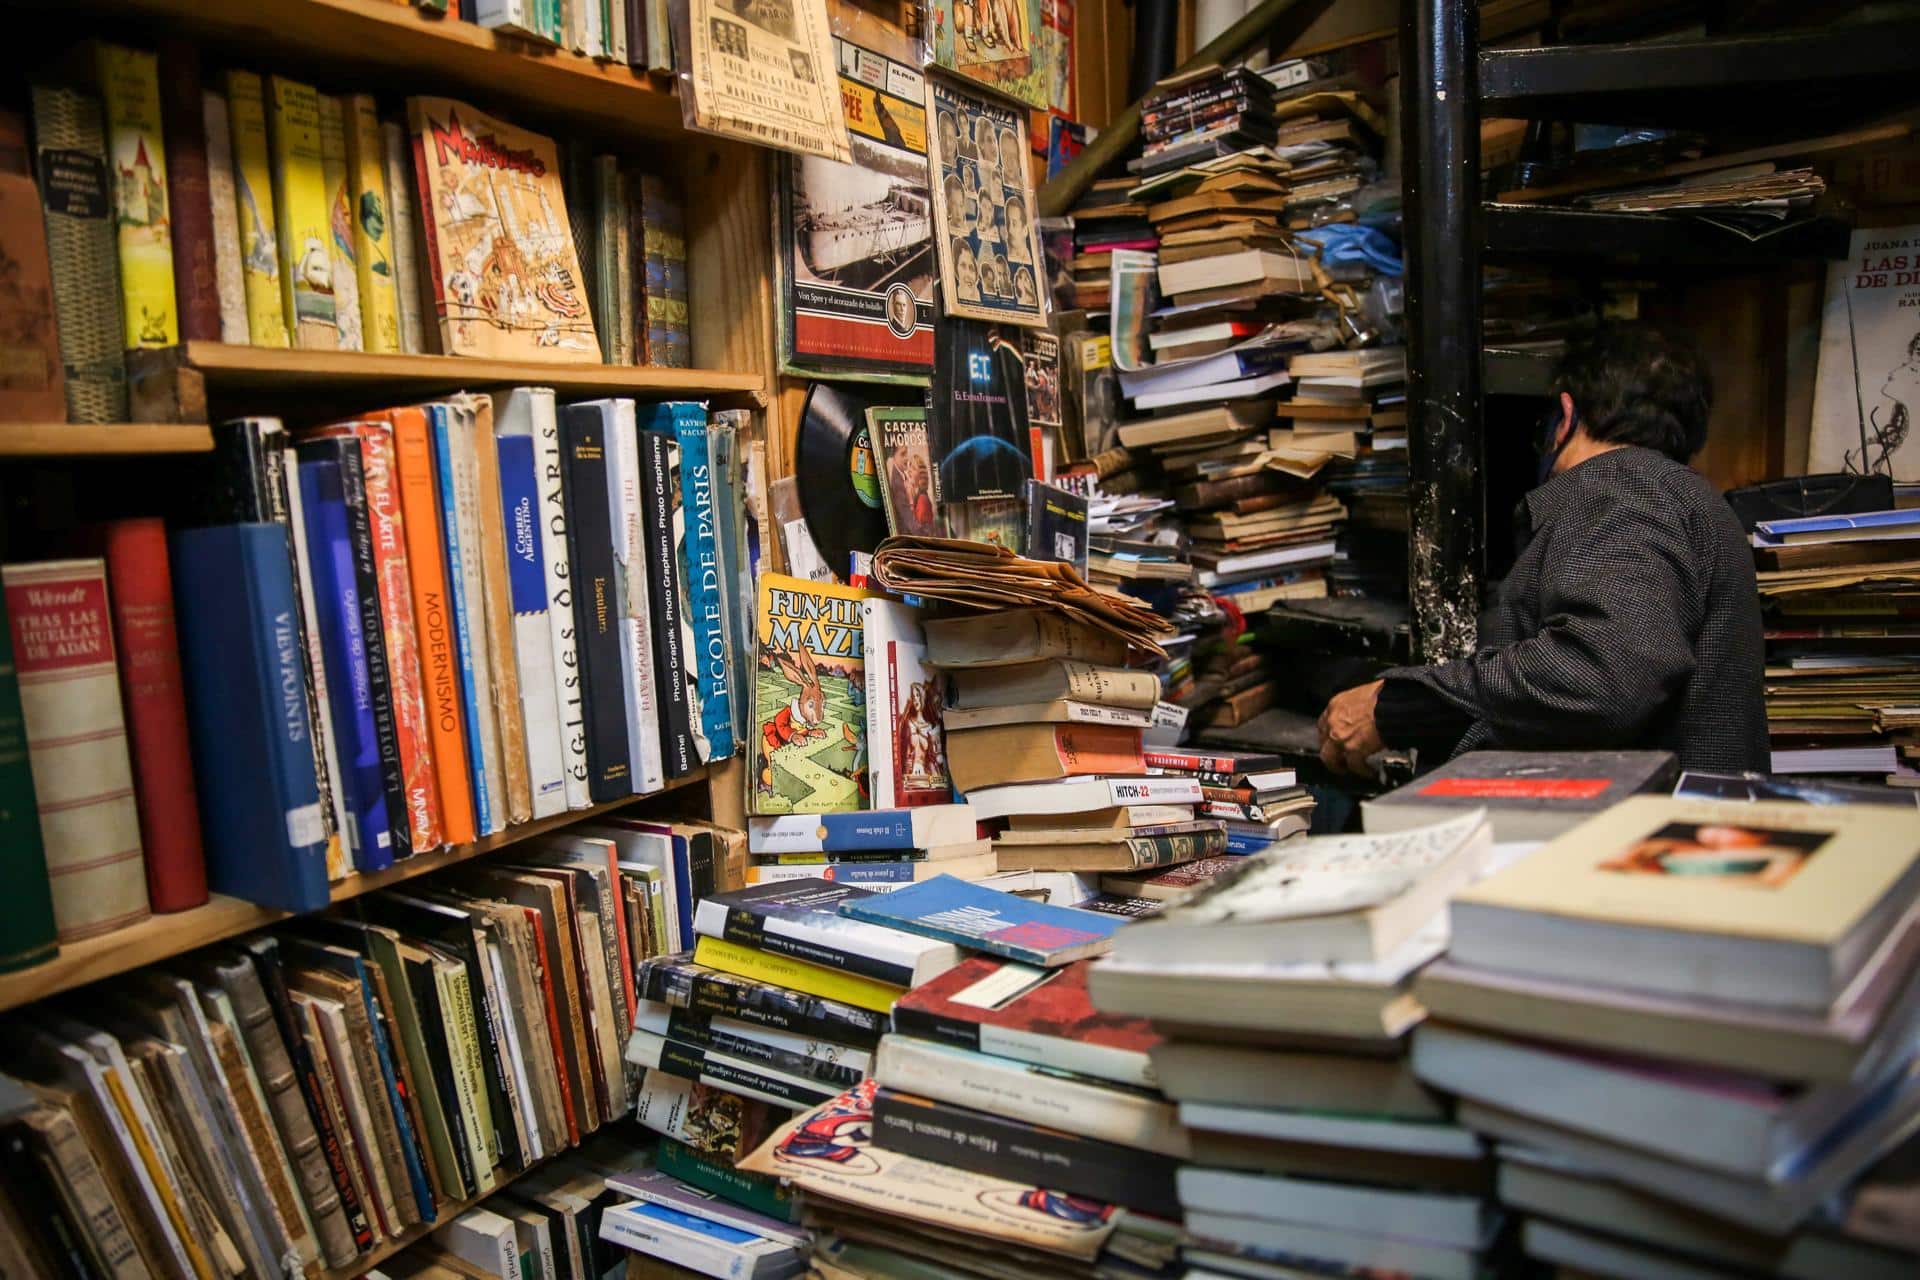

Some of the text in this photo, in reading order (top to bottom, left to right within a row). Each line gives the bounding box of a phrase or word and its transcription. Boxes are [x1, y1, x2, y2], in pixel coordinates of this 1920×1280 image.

[1864, 239, 1909, 250] JUANA
[1862, 256, 1908, 272] LAS
[1856, 273, 1888, 288] DE
[884, 421, 927, 432] CARTAS
[378, 510, 397, 550] ARTE
[514, 506, 530, 554] CORREO
[523, 497, 535, 562] ARGENTINO
[652, 436, 682, 702] Photo Graphik Photo Graphism Photo Graphisme
[692, 464, 728, 698] ECOLE DE PARIS
[27, 586, 86, 607] Wendt
[17, 608, 97, 631] TRAS LAS
[21, 625, 101, 646] HUELLAS
[362, 596, 385, 684] ESPAÑOLA
[26, 643, 49, 661] DE
[425, 592, 456, 733] MODERNISMO
[275, 612, 302, 742] VIEWPOINTS
[677, 734, 688, 772] Barthel
[386, 768, 400, 792] LA
[1115, 784, 1150, 798] HITCH-22
[767, 1082, 790, 1097] Manual
[952, 1132, 966, 1145] de
[967, 1132, 998, 1154] Hijos
[503, 1240, 519, 1279] Gabriel
